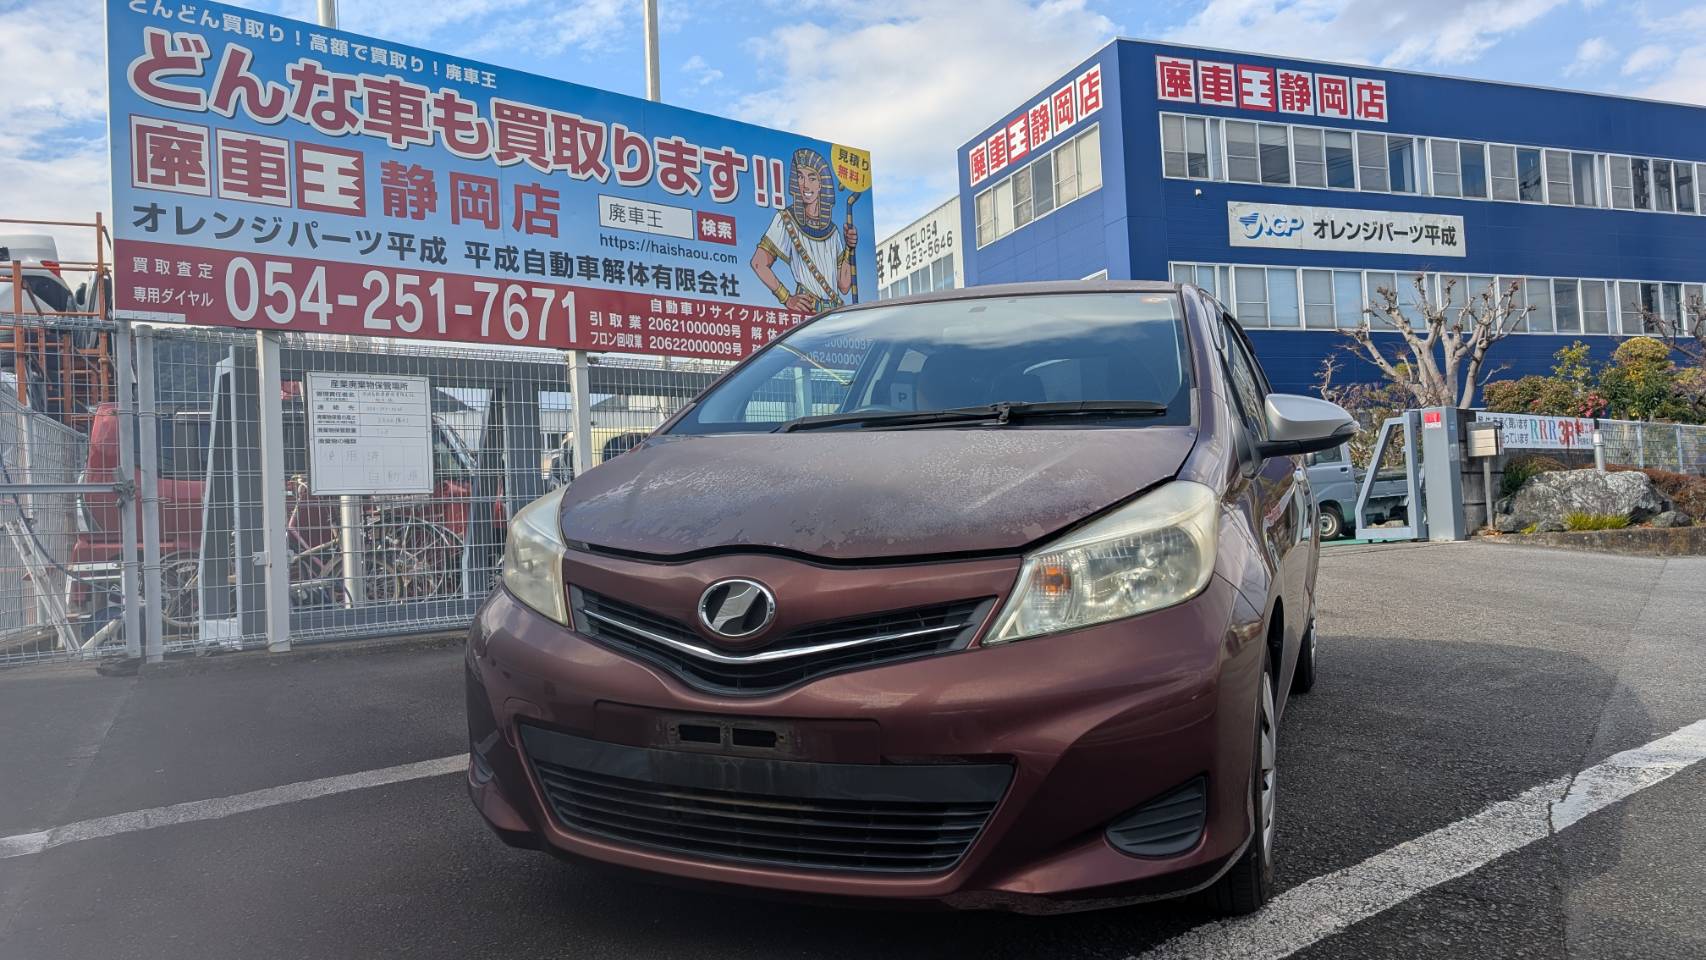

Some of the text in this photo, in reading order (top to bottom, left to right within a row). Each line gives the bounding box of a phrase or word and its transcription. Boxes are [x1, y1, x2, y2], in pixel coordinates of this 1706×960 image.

[1159, 57, 1387, 121] 廃車王静岡店
[970, 65, 1101, 185] 廃車王静岡店
[609, 203, 663, 228] 廃車王
[701, 217, 732, 240] 検索
[1313, 219, 1457, 247] オレンジパーツ平成
[132, 203, 741, 298] オレンジパーツ平成 平成自動車解体有限会社
[600, 233, 738, 264] https://haishaou.com
[132, 256, 214, 280] 買取査定
[133, 286, 214, 307] 専用ダイヤル
[225, 256, 577, 343] 054-251-7671
[589, 311, 642, 330] 引取業
[648, 317, 742, 339] 20621000009号
[590, 331, 643, 349] フロン回収業
[649, 336, 743, 357] 20622000009号
